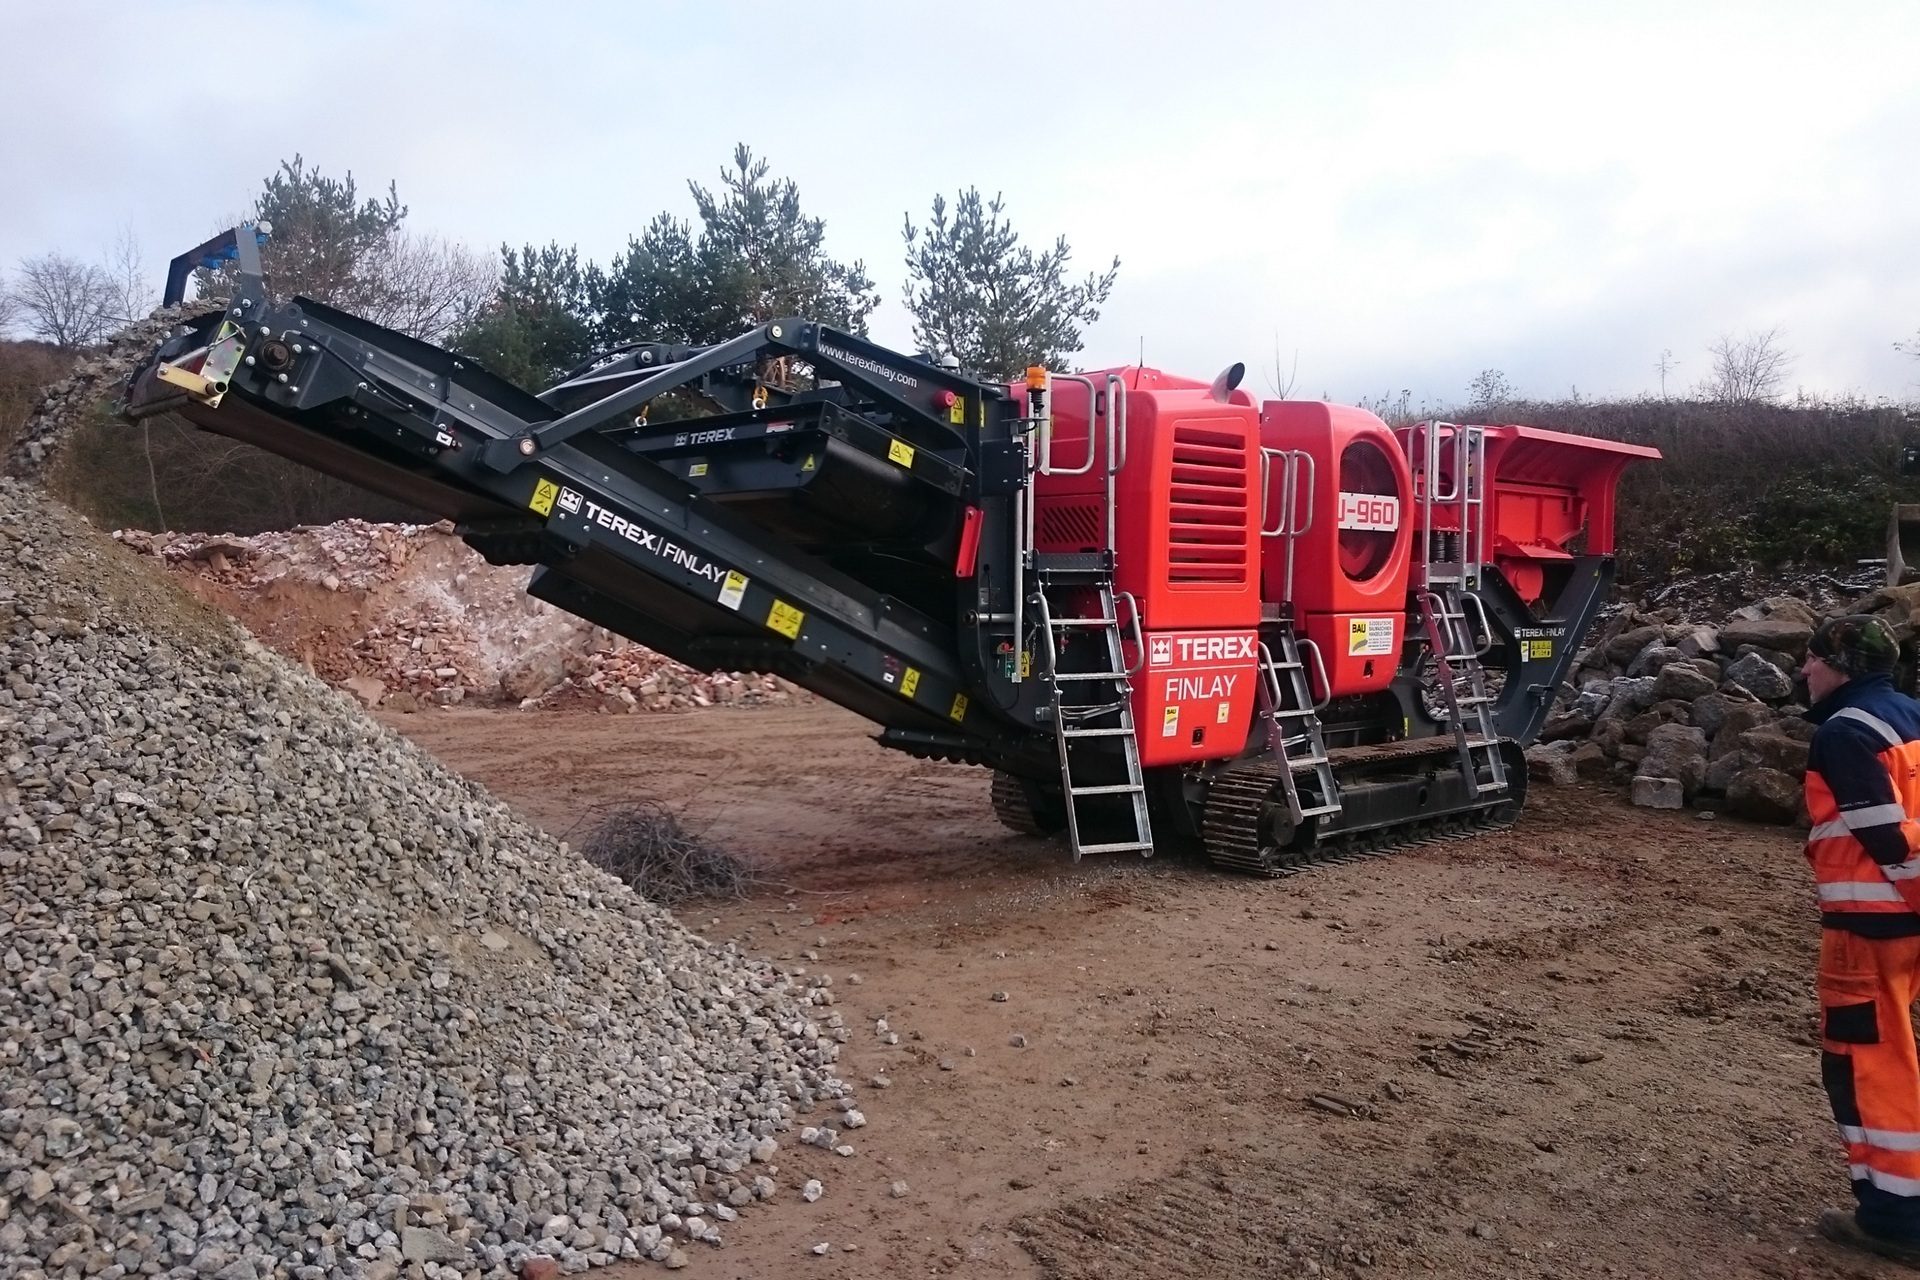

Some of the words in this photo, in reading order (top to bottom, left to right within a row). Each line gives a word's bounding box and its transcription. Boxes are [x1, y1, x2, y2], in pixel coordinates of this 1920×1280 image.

[818, 343, 918, 388] www.terexfinlay.com
[690, 427, 735, 444] TEREX
[662, 542, 726, 583] FINLAY
[1352, 624, 1366, 633] BAU
[1521, 628, 1545, 637] TEREX
[1165, 674, 1237, 701] FINLAY
